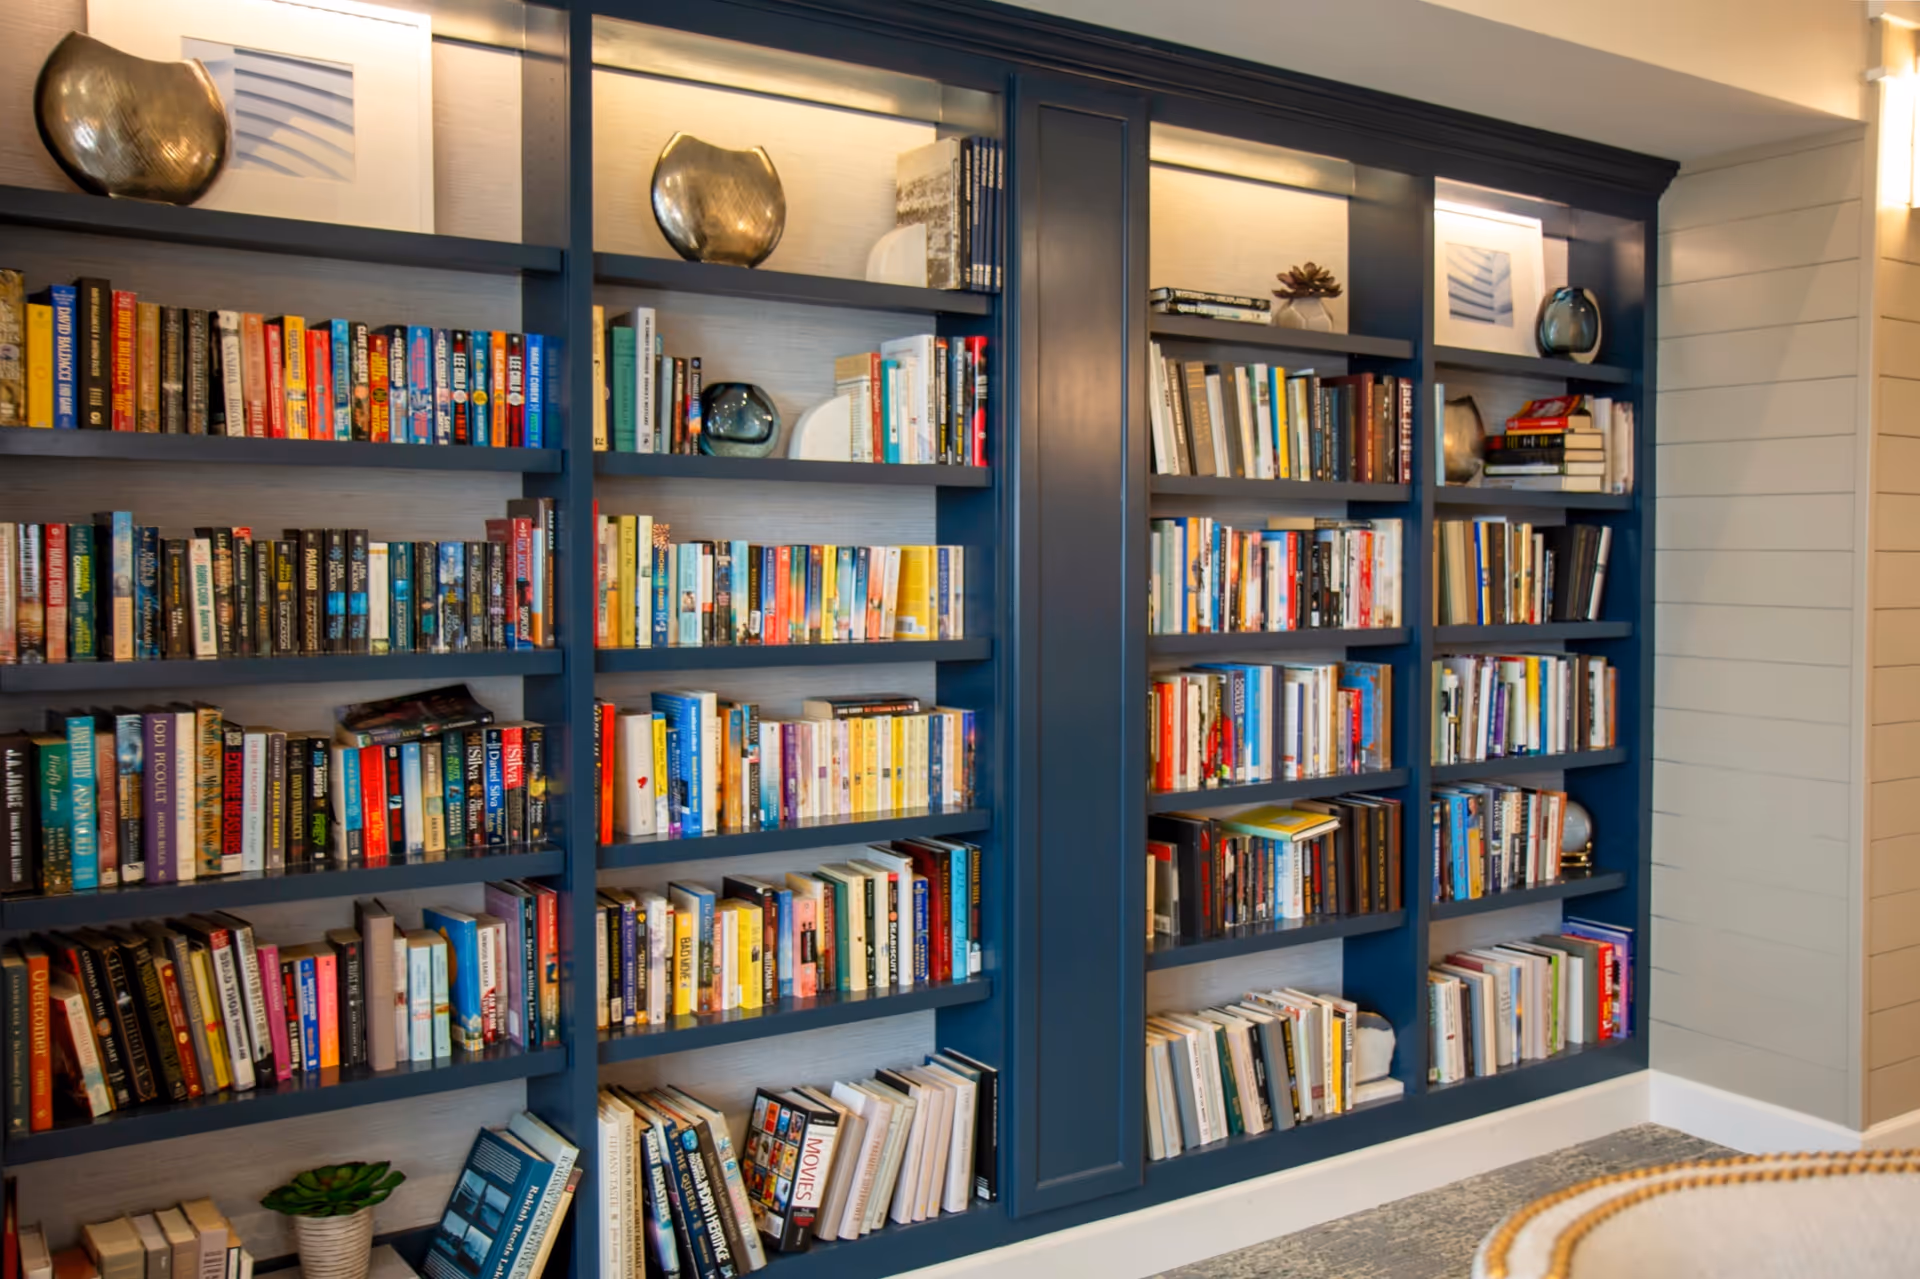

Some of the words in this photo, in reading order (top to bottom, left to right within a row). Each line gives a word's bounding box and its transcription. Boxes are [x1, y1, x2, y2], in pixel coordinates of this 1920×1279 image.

[57, 306, 72, 335] DAVID
[117, 310, 132, 338] DAVID
[357, 325, 368, 348] CLIVE
[57, 336, 72, 381] BALDACCI
[117, 341, 132, 386] BALDACCI
[357, 349, 368, 384] CUSSLER
[454, 353, 466, 366] LEE
[509, 356, 521, 370] LEE
[530, 346, 540, 375] HARLAN
[454, 367, 466, 390] CHILD
[509, 371, 521, 393] CHILD
[530, 376, 540, 403] COBEN
[518, 538, 526, 552] LISA
[48, 548, 64, 578] HARLAN
[73, 555, 82, 600] CONNELLY
[196, 564, 209, 587] ROBIN
[306, 549, 318, 591] PARANOID
[329, 560, 338, 592] JACKSON
[352, 560, 361, 592] JACKSON
[656, 548, 666, 586] NICHOLAS
[48, 579, 64, 605] COBEN
[196, 588, 209, 607] COOK
[218, 625, 230, 643] HER
[306, 614, 314, 651] JACKSON
[153, 719, 169, 749] JODI
[6, 749, 24, 771] J.A.
[468, 749, 483, 781] Silva
[489, 750, 501, 782] Daniel
[507, 749, 524, 785] Silva
[531, 742, 541, 763] Daniel
[47, 754, 63, 786] Firefly
[153, 751, 169, 805] PICOULT
[224, 752, 243, 800] EXTREME
[312, 766, 327, 799] SANDFORD
[6, 771, 24, 809] JANCE
[47, 788, 63, 812] Lane
[73, 784, 96, 821] ASPEN
[273, 781, 281, 799] DEAD
[291, 774, 303, 800] DAVID
[489, 784, 501, 808] Silva
[273, 801, 281, 817] GIRL
[469, 799, 478, 830] ORDER
[487, 813, 497, 833] Rules
[496, 807, 504, 836] Moscow
[536, 801, 544, 824] House
[73, 821, 96, 856] GOLD
[224, 801, 243, 855] MEASURES
[273, 818, 281, 850] RUNNING
[312, 813, 326, 847] PREY
[48, 827, 57, 863] HANNAH
[972, 885, 980, 905] STEEL
[611, 915, 620, 929] THE
[480, 931, 490, 961] LINWOOD
[679, 937, 692, 957] BAD
[889, 921, 898, 973] SEABISCUIT
[246, 953, 261, 988] BRAD
[348, 960, 360, 984] TRUST
[679, 958, 692, 981] MOVE
[33, 969, 51, 1057] Overcomer
[82, 950, 98, 988] COMPASS
[104, 1037, 117, 1064] HEART
[225, 986, 239, 1018] THOR
[253, 989, 265, 1025] THOR
[526, 1002, 534, 1021] Lane
[608, 1135, 619, 1176] TIFFANY
[647, 1131, 662, 1165] GREAT
[673, 1148, 688, 1171] THE
[626, 1177, 632, 1188] OF
[795, 1137, 824, 1202] MOVIES
[518, 1184, 540, 1223] Rakish
[608, 1177, 619, 1208] TASTE
[651, 1166, 672, 1223] DISASTERS
[678, 1172, 700, 1212] QUEEN
[694, 1181, 718, 1217] INDIAN
[503, 1223, 524, 1257] Reeds
[704, 1215, 732, 1262] HERITAGE
